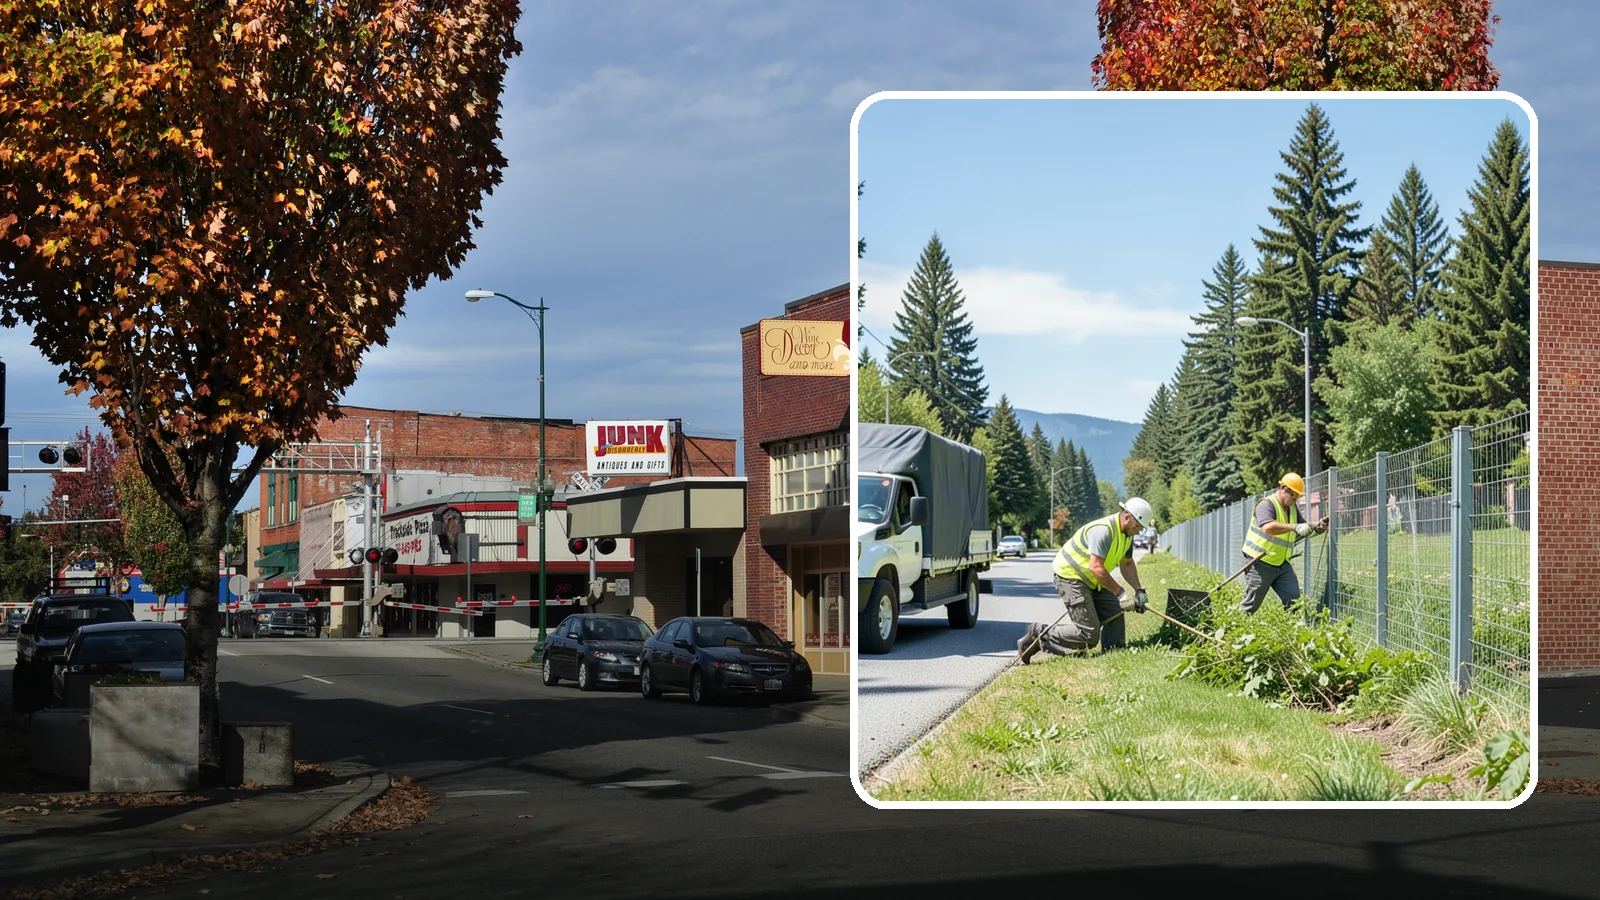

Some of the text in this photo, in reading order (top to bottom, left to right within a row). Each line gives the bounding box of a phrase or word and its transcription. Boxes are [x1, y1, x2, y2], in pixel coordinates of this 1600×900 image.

[595, 425, 665, 457] JUNK
[607, 446, 646, 454] DISORDERLY
[597, 460, 666, 470] ANTIQUES AND GIFTS
[352, 498, 365, 511] CRO
[390, 519, 429, 539] Trackside Pizza
